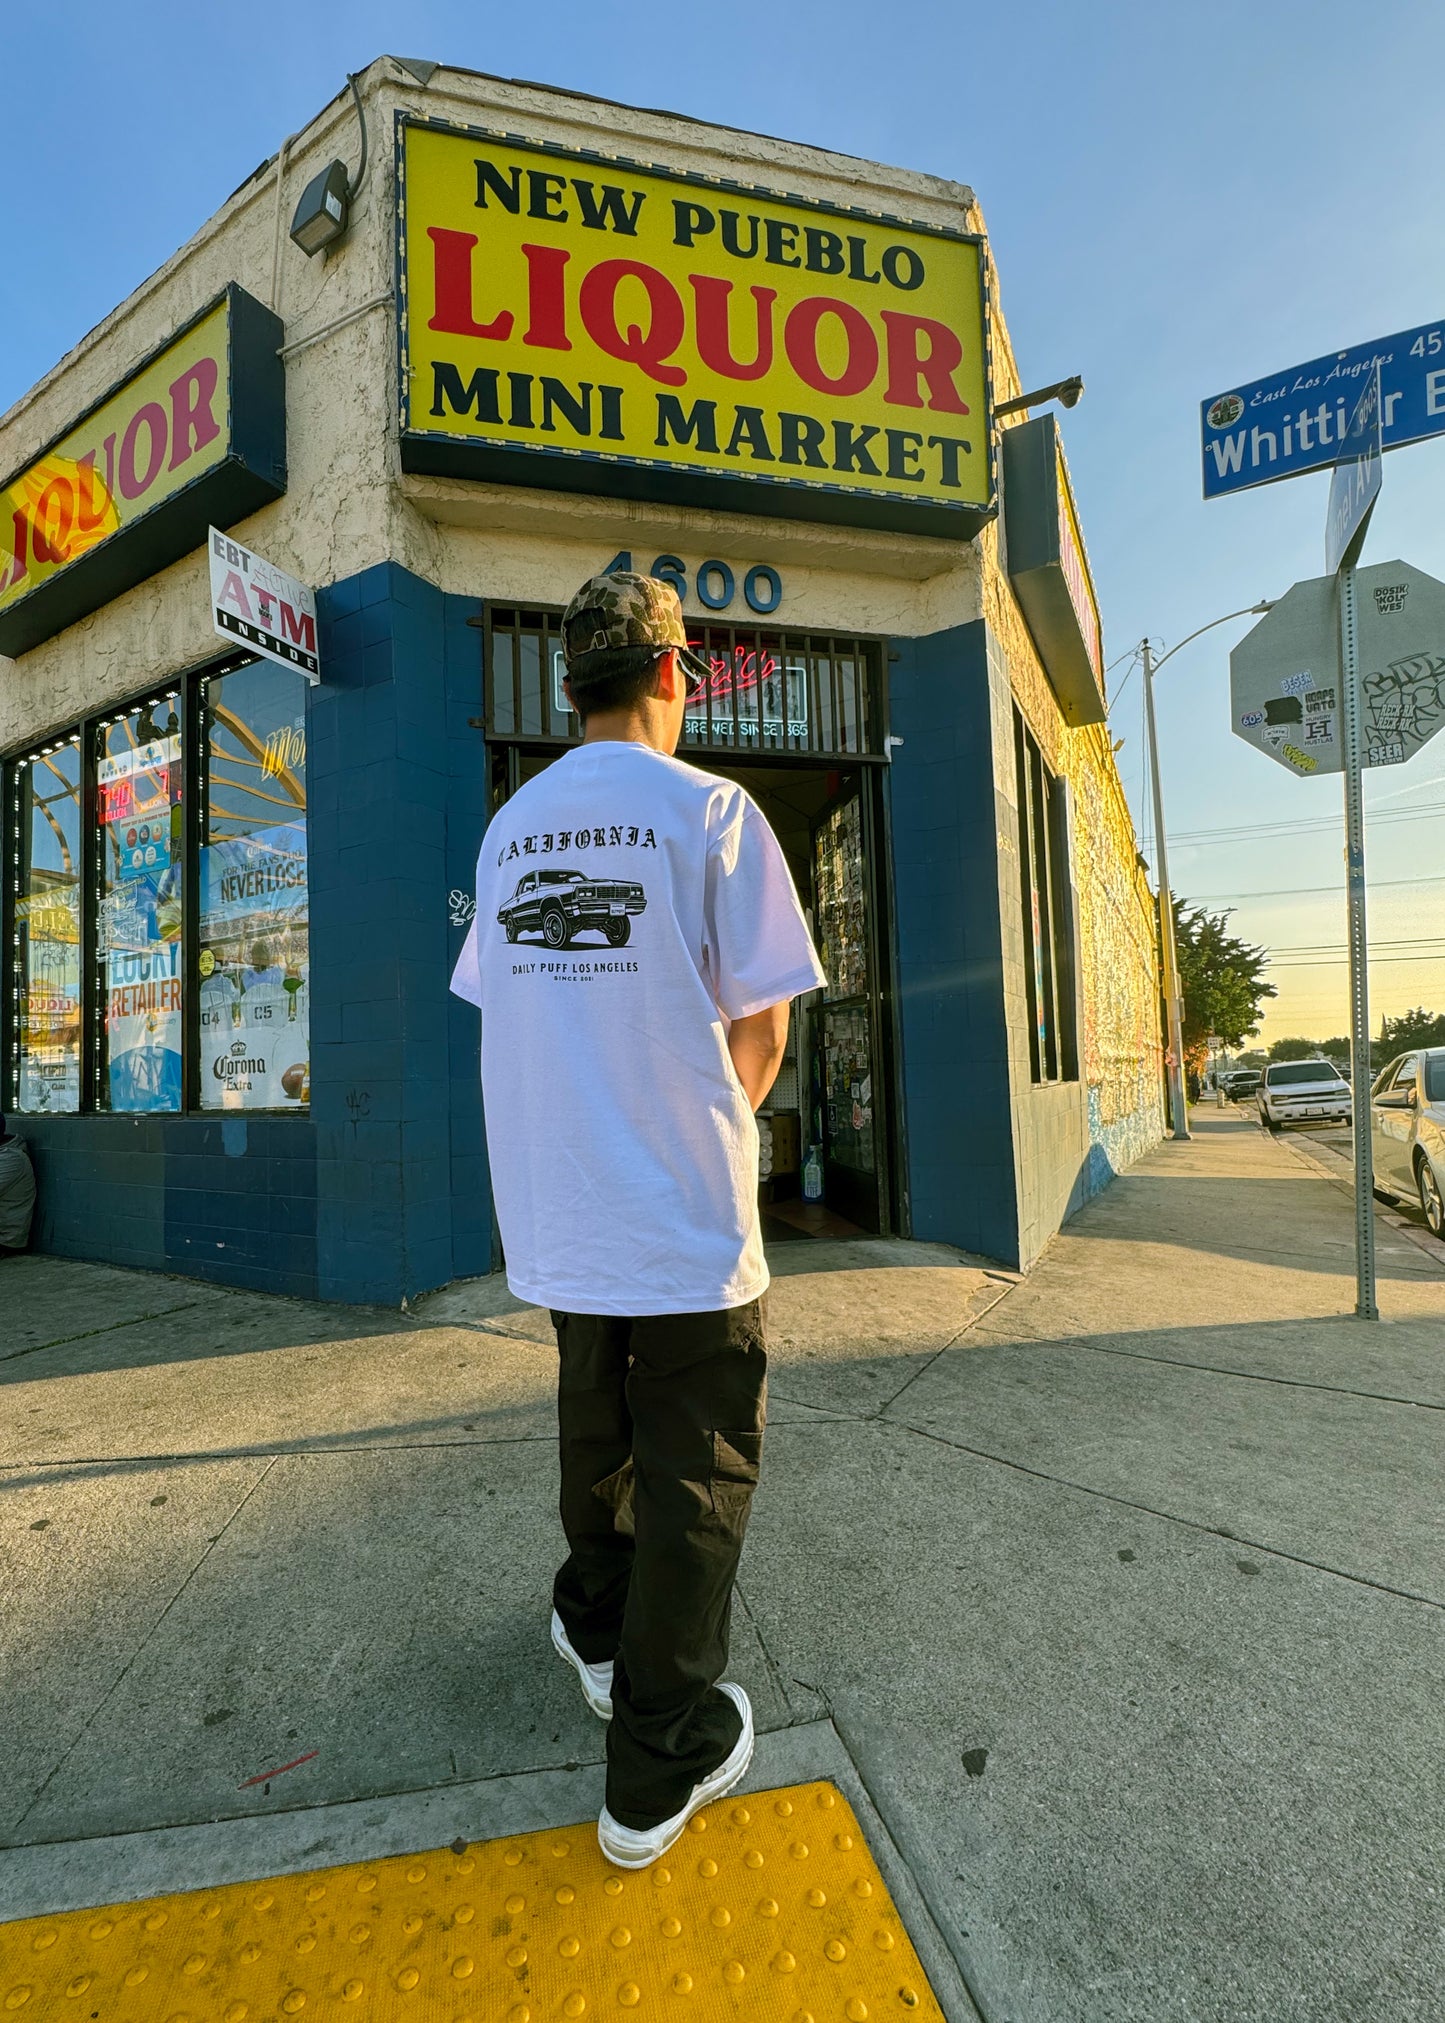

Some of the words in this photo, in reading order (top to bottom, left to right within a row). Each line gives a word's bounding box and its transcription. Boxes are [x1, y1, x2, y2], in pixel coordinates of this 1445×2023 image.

[473, 159, 646, 237] NEW
[672, 200, 925, 291] PUEBLO
[426, 226, 970, 416] LIQUOR
[1250, 390, 1286, 407] East
[1291, 376, 1321, 394] Los
[1323, 353, 1394, 386] Angeles
[1409, 331, 1445, 357] 45
[430, 361, 624, 441] MINI
[654, 393, 971, 488] MARKET
[1212, 391, 1403, 478] Whittir
[0, 357, 221, 593] IQUOR
[214, 533, 250, 573] EBT
[217, 569, 316, 653] ATM
[222, 613, 315, 670] INSIDE
[1243, 713, 1263, 726] 605
[498, 826, 657, 867] CALIFORNIA
[221, 870, 264, 903] NEVER
[268, 861, 305, 892] LOSE
[112, 942, 178, 985] LUCKY
[512, 963, 536, 975] DAILY
[540, 963, 567, 973] PUFF
[573, 963, 591, 973] LOS
[594, 962, 638, 973] ANGELES
[112, 978, 181, 1018] RETAILER
[213, 1055, 266, 1080] Corona
[224, 1077, 252, 1091] Extra
